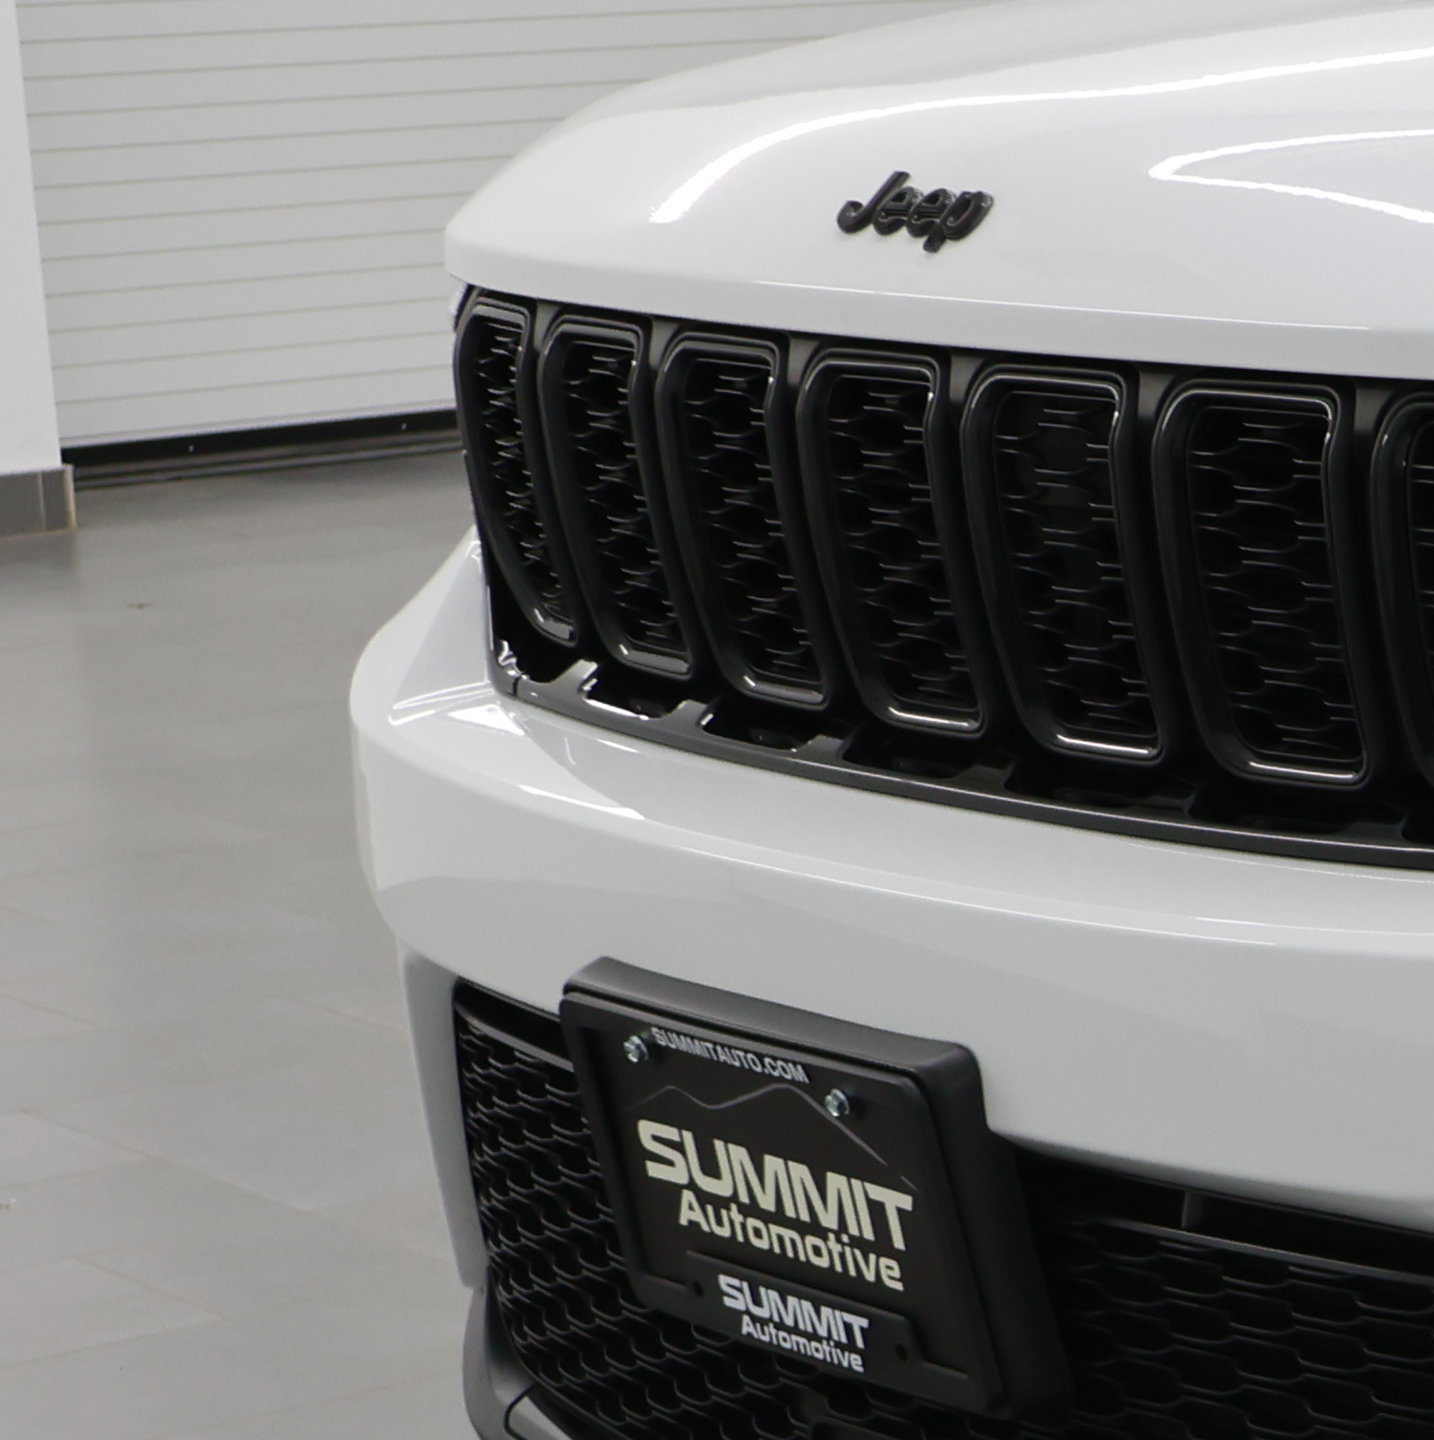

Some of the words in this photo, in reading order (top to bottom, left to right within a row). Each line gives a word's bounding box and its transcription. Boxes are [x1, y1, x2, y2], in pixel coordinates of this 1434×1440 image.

[836, 170, 994, 253] Jeep
[651, 1026, 810, 1084] SUMMITAUTO.COM
[637, 1119, 913, 1251] SUMMIT
[679, 1190, 904, 1291] Automotive
[718, 1274, 870, 1349] SUMMIT
[741, 1314, 864, 1373] Automotive
